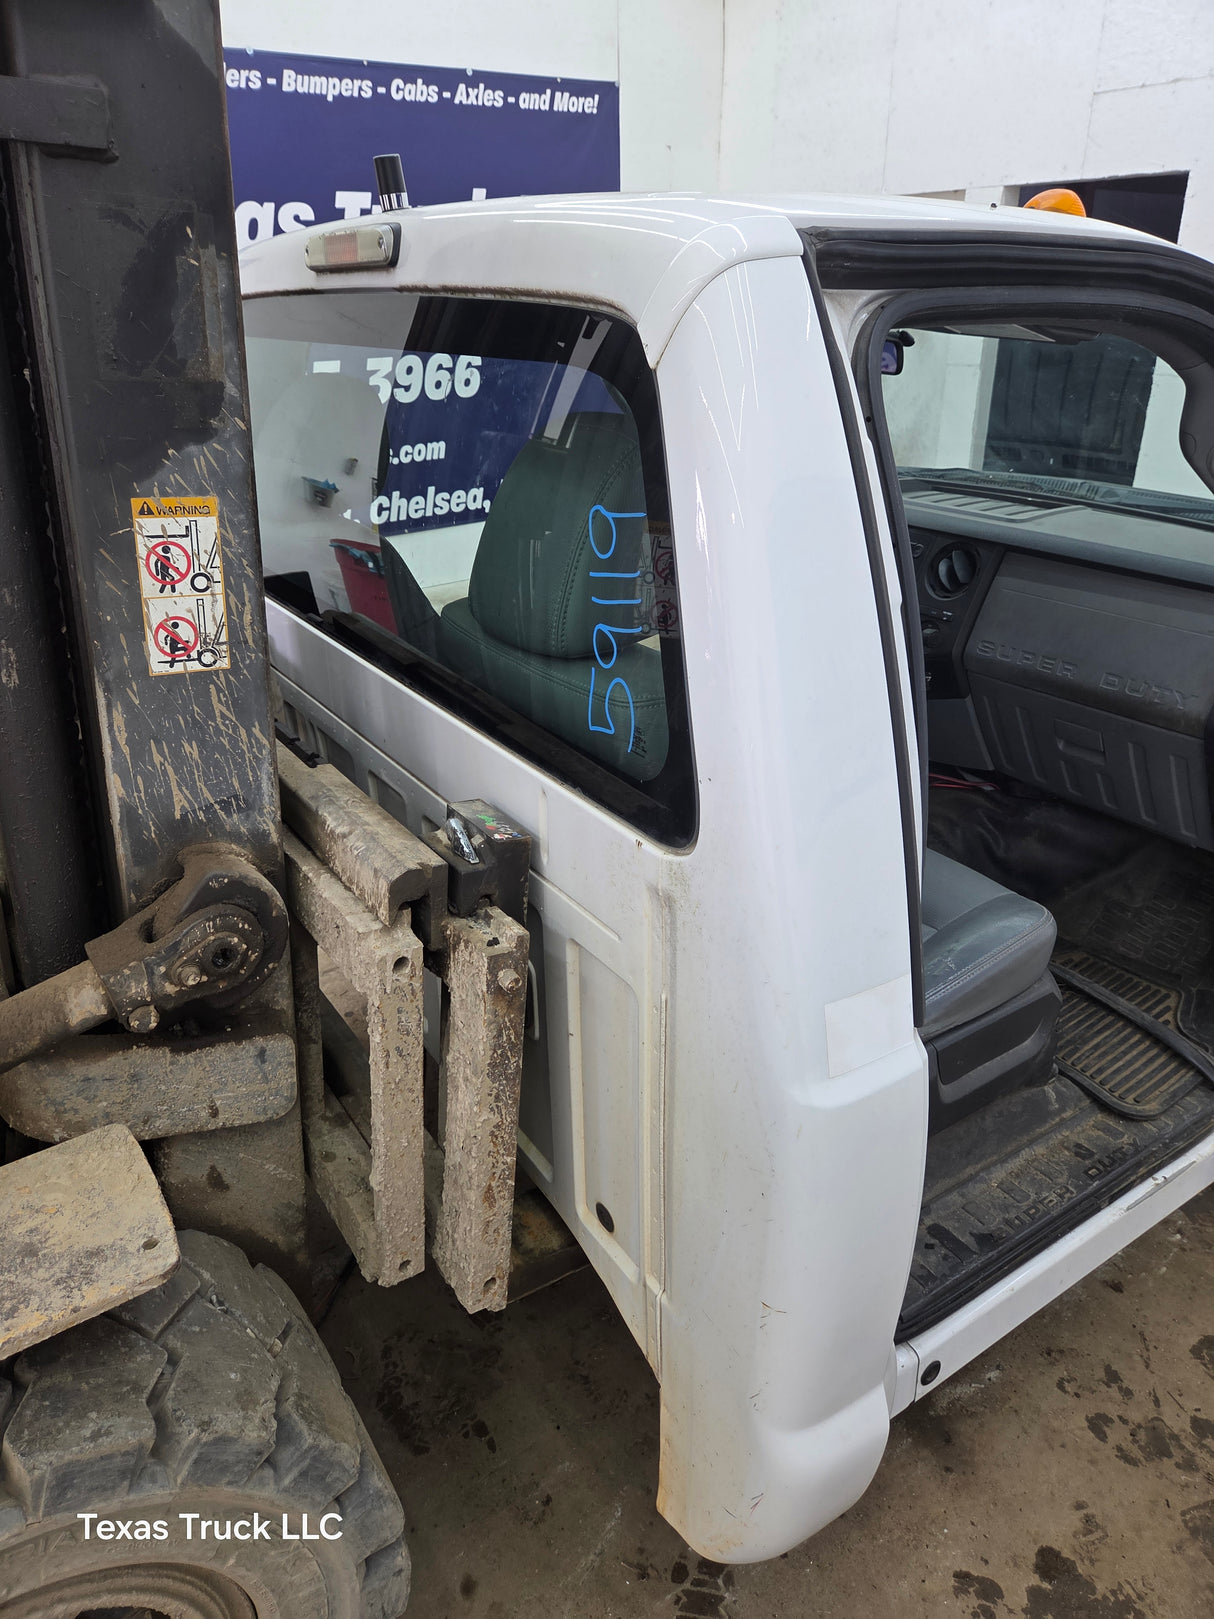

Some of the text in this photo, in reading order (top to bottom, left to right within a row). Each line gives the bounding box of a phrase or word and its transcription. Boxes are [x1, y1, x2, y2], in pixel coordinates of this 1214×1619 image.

[223, 62, 262, 90] ers
[281, 69, 373, 103] Bumpers
[390, 78, 439, 103] Cabs
[453, 83, 504, 108] Axles
[518, 88, 552, 112] and
[553, 91, 600, 115] More!
[366, 353, 483, 404] 3966
[389, 440, 446, 465] .com
[156, 504, 211, 516] WARNING
[369, 486, 491, 525] Chelsea,
[976, 638, 1199, 711] SUPER DUTY
